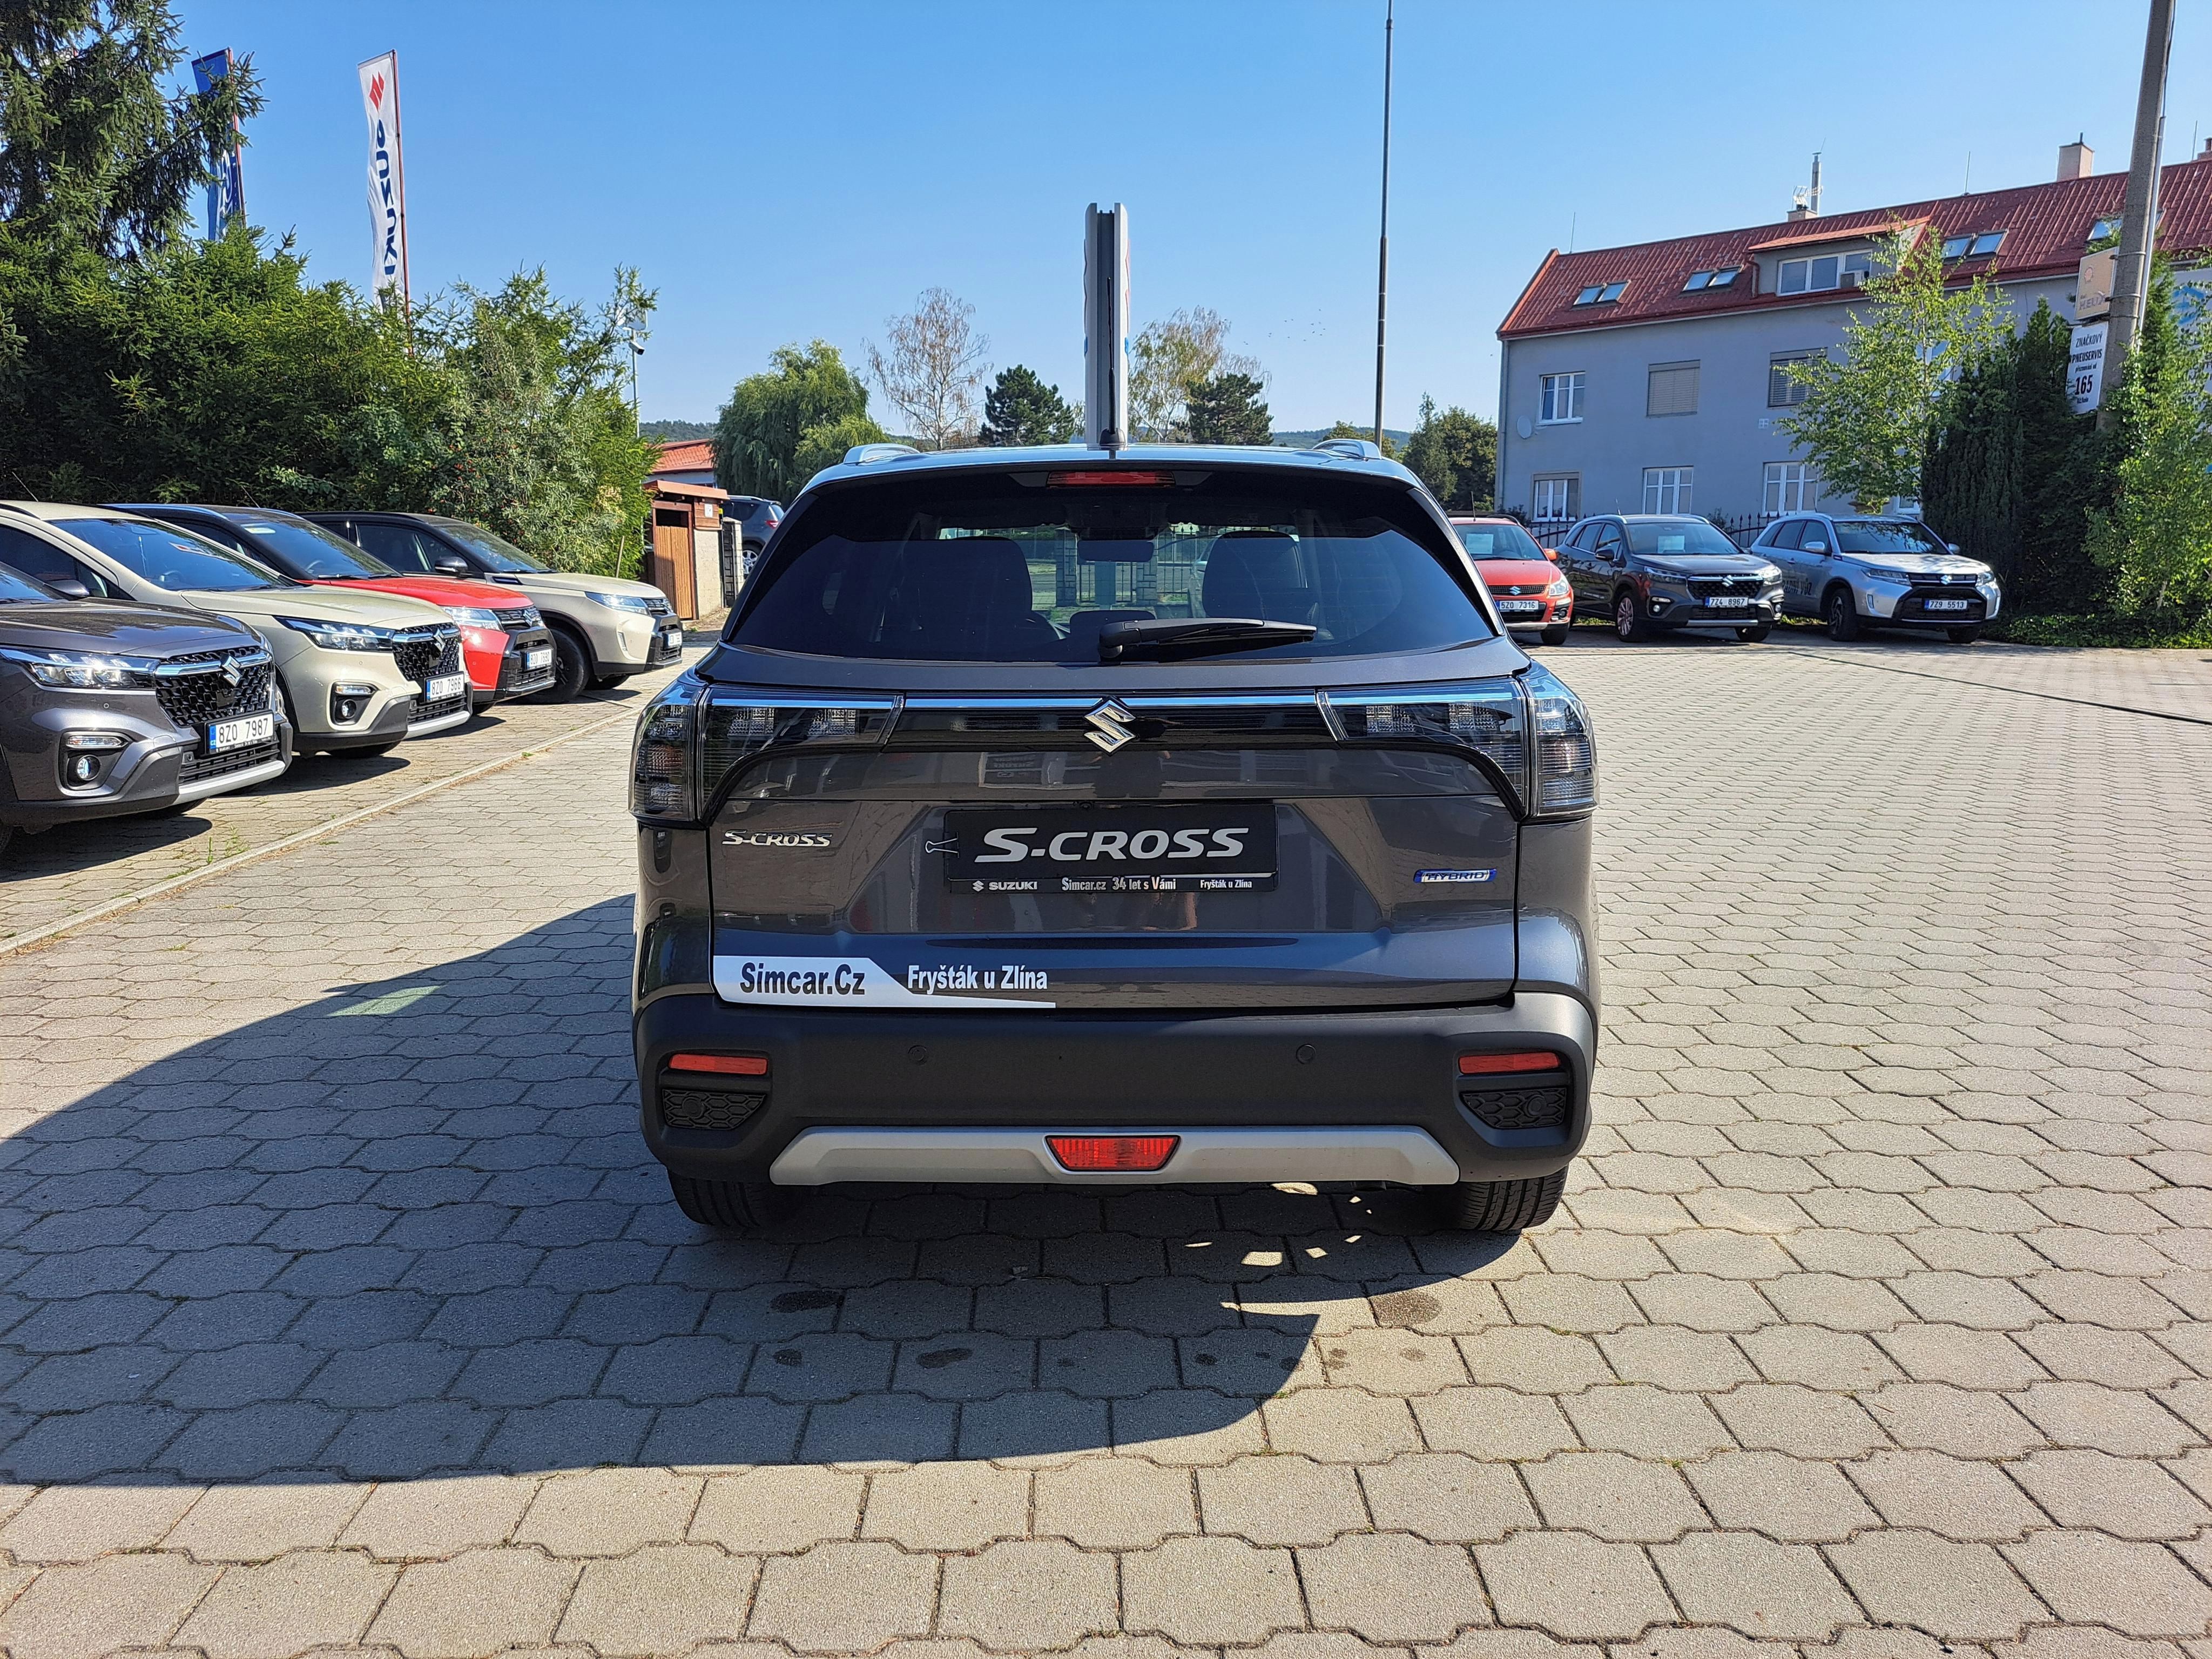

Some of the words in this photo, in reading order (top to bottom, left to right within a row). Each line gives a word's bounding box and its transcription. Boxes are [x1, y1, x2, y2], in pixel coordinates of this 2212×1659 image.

[2075, 331, 2103, 348] ZNAČKOVÝ
[2072, 349, 2103, 363] PNEUSERVIS
[2075, 374, 2093, 395] 165
[448, 677, 461, 692] 7966
[219, 724, 238, 744] 8Z0
[246, 718, 268, 739] 7987
[722, 830, 833, 847] S-CROSS
[974, 827, 1249, 863] S-CROSS
[988, 881, 1038, 891] SUZUKI
[1062, 876, 1107, 891] Simcar.cz
[1111, 876, 1127, 890] 34
[1129, 879, 1141, 890] let
[1143, 881, 1149, 890] s
[1151, 876, 1176, 890] Vámi
[1200, 879, 1226, 890] Fryšták
[1235, 879, 1252, 888] Zlína
[1426, 872, 1485, 881] HYBRID
[739, 961, 866, 995] Simcar.Cz
[908, 965, 979, 995] Fryšták
[983, 972, 998, 989] u
[1001, 965, 1048, 990] Zlína
